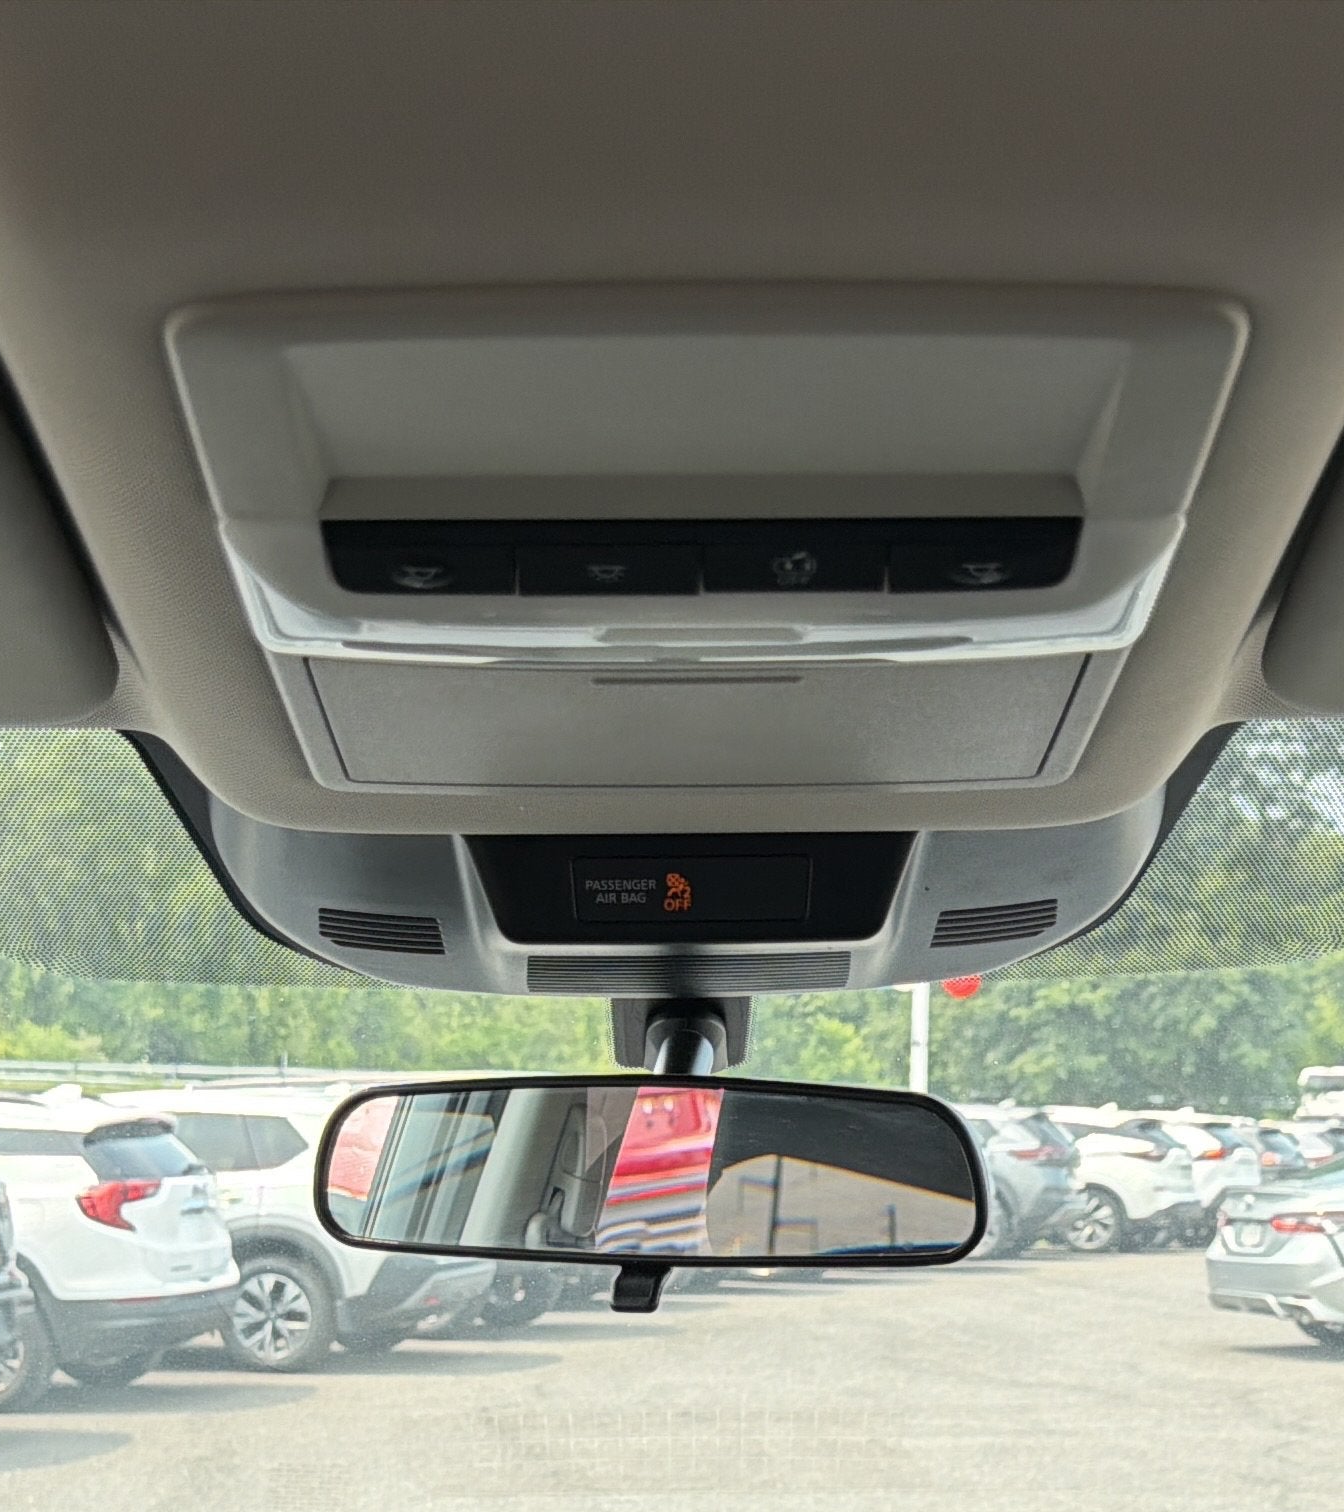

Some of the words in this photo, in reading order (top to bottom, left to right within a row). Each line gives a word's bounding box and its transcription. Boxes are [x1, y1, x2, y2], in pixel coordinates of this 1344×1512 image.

[585, 880, 656, 890] PASSENGER
[596, 892, 616, 904] AIR
[621, 892, 646, 904] BAG
[664, 898, 692, 910] OFF
